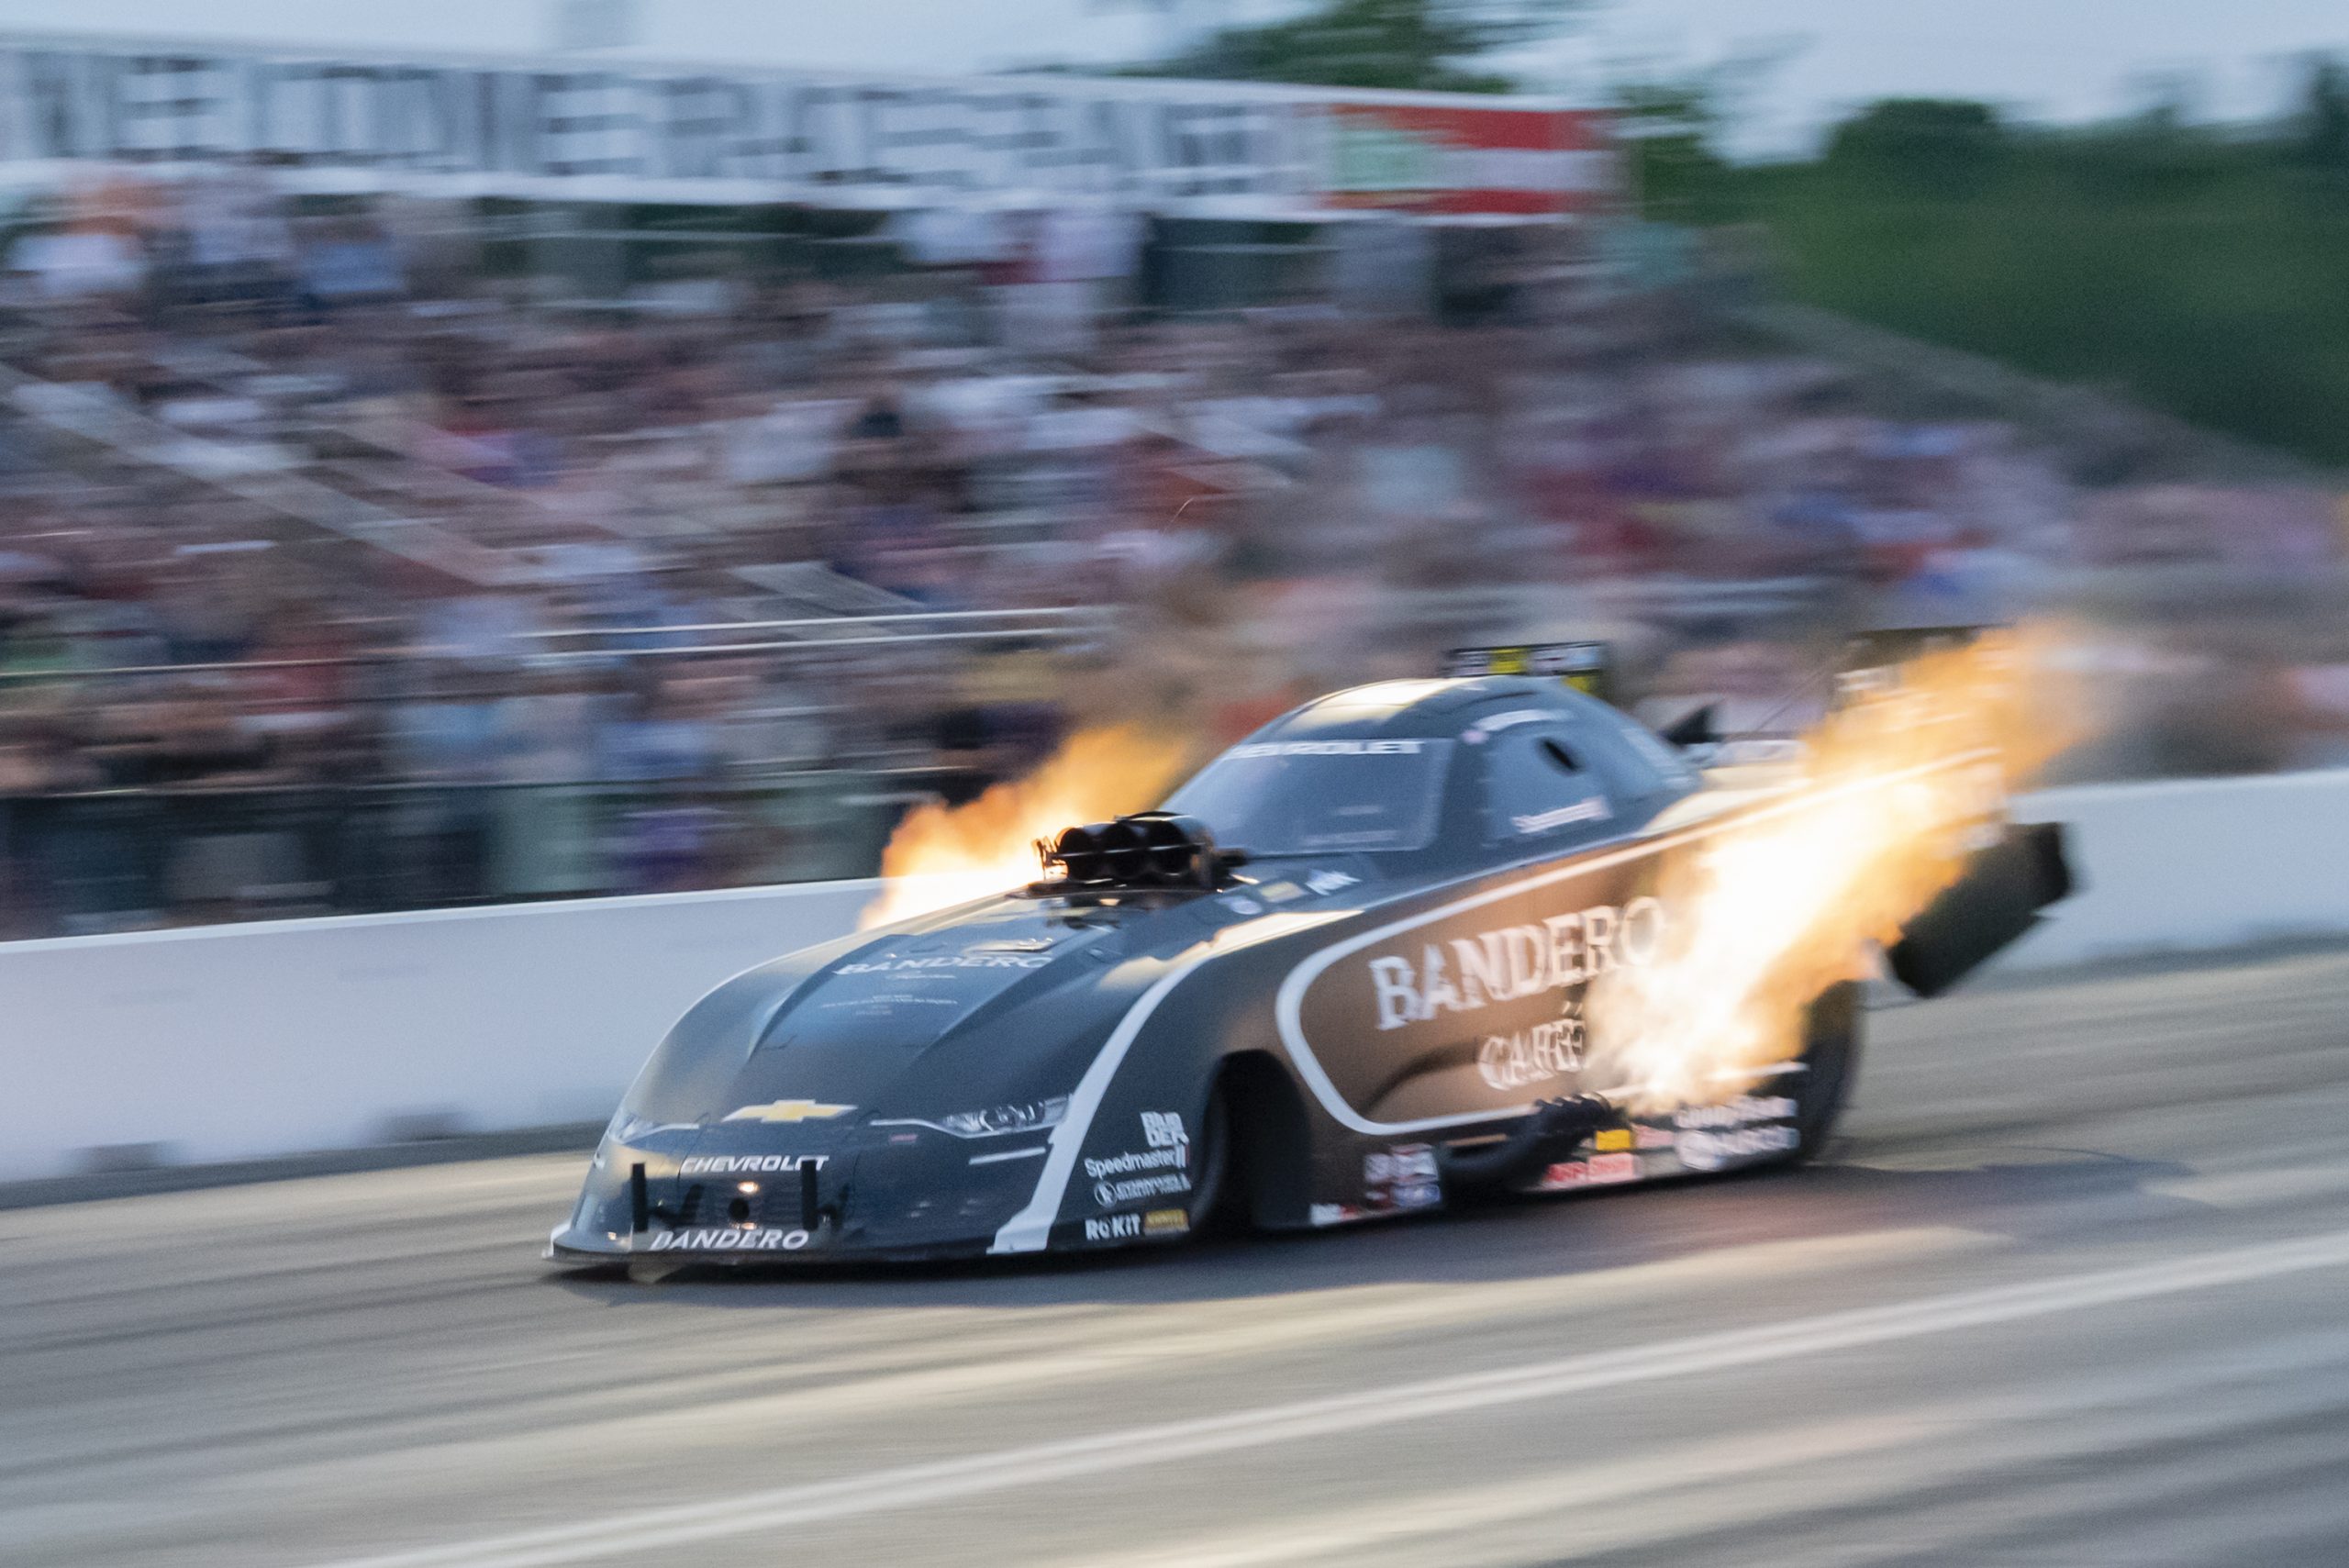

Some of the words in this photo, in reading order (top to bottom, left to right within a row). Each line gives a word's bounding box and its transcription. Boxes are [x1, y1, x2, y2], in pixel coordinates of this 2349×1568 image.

[832, 955, 1053, 974] BANDERO
[1367, 896, 1665, 1030] BANDERO
[1084, 1150, 1175, 1179] Speedmaster
[648, 1229, 809, 1251] BANDERO
